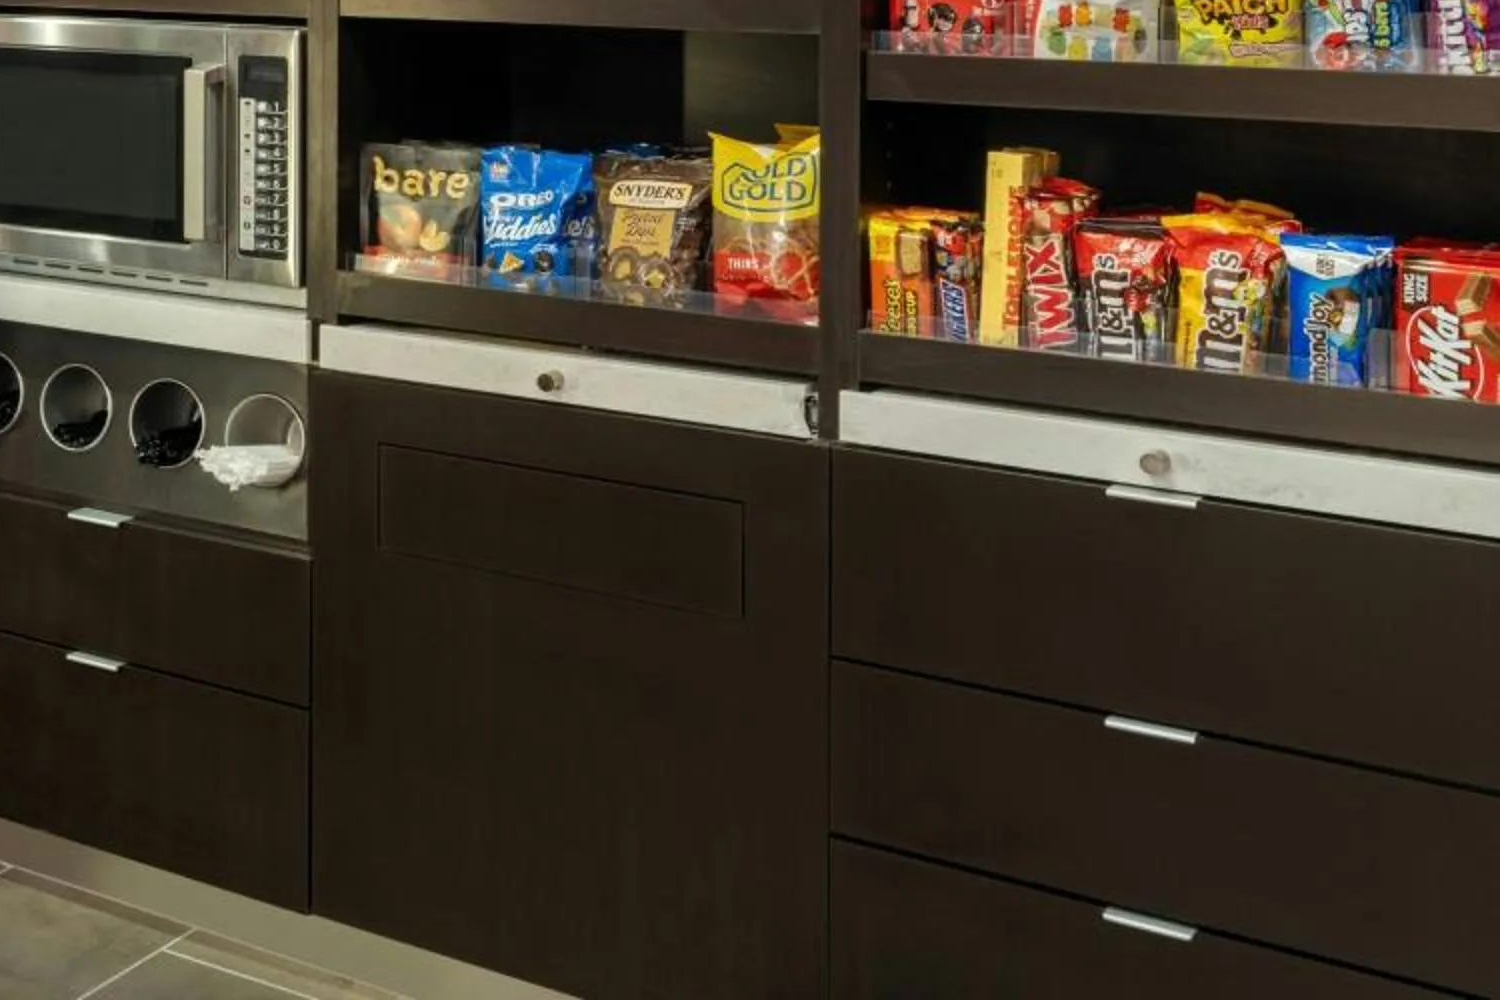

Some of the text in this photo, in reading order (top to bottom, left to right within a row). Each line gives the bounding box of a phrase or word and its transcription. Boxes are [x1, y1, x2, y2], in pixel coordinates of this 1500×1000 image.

[372, 156, 470, 200] bare
[613, 183, 686, 200] SNYDER'S
[729, 177, 807, 202] GOLD
[1001, 185, 1024, 331] TOBLERONE
[1024, 235, 1077, 348] TWIX
[1403, 272, 1415, 303] KING
[1415, 274, 1428, 303] SIZE
[943, 281, 967, 341] NICKERS
[1304, 325, 1330, 385] mond
